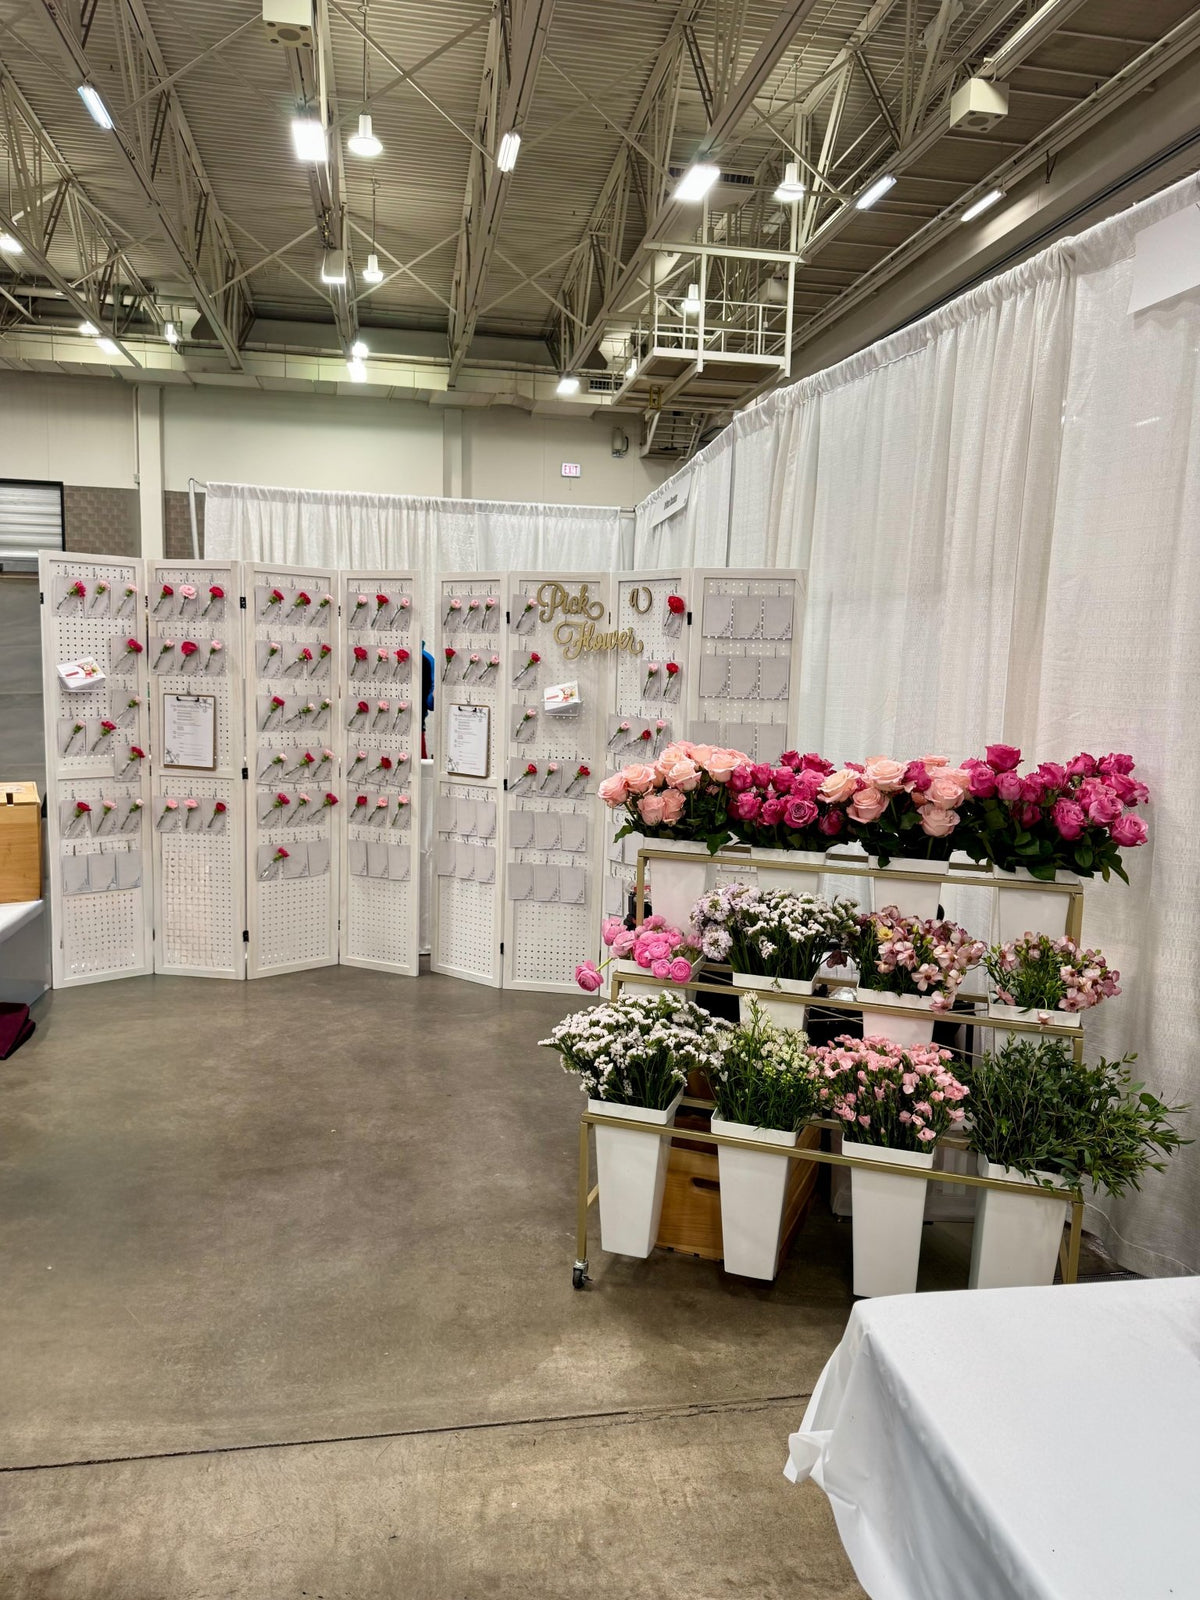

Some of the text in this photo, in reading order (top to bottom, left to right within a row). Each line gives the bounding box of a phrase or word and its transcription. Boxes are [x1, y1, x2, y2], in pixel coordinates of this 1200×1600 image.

[564, 465, 578, 476] EXIT
[537, 581, 605, 623] Pick
[553, 620, 644, 660] Flower
